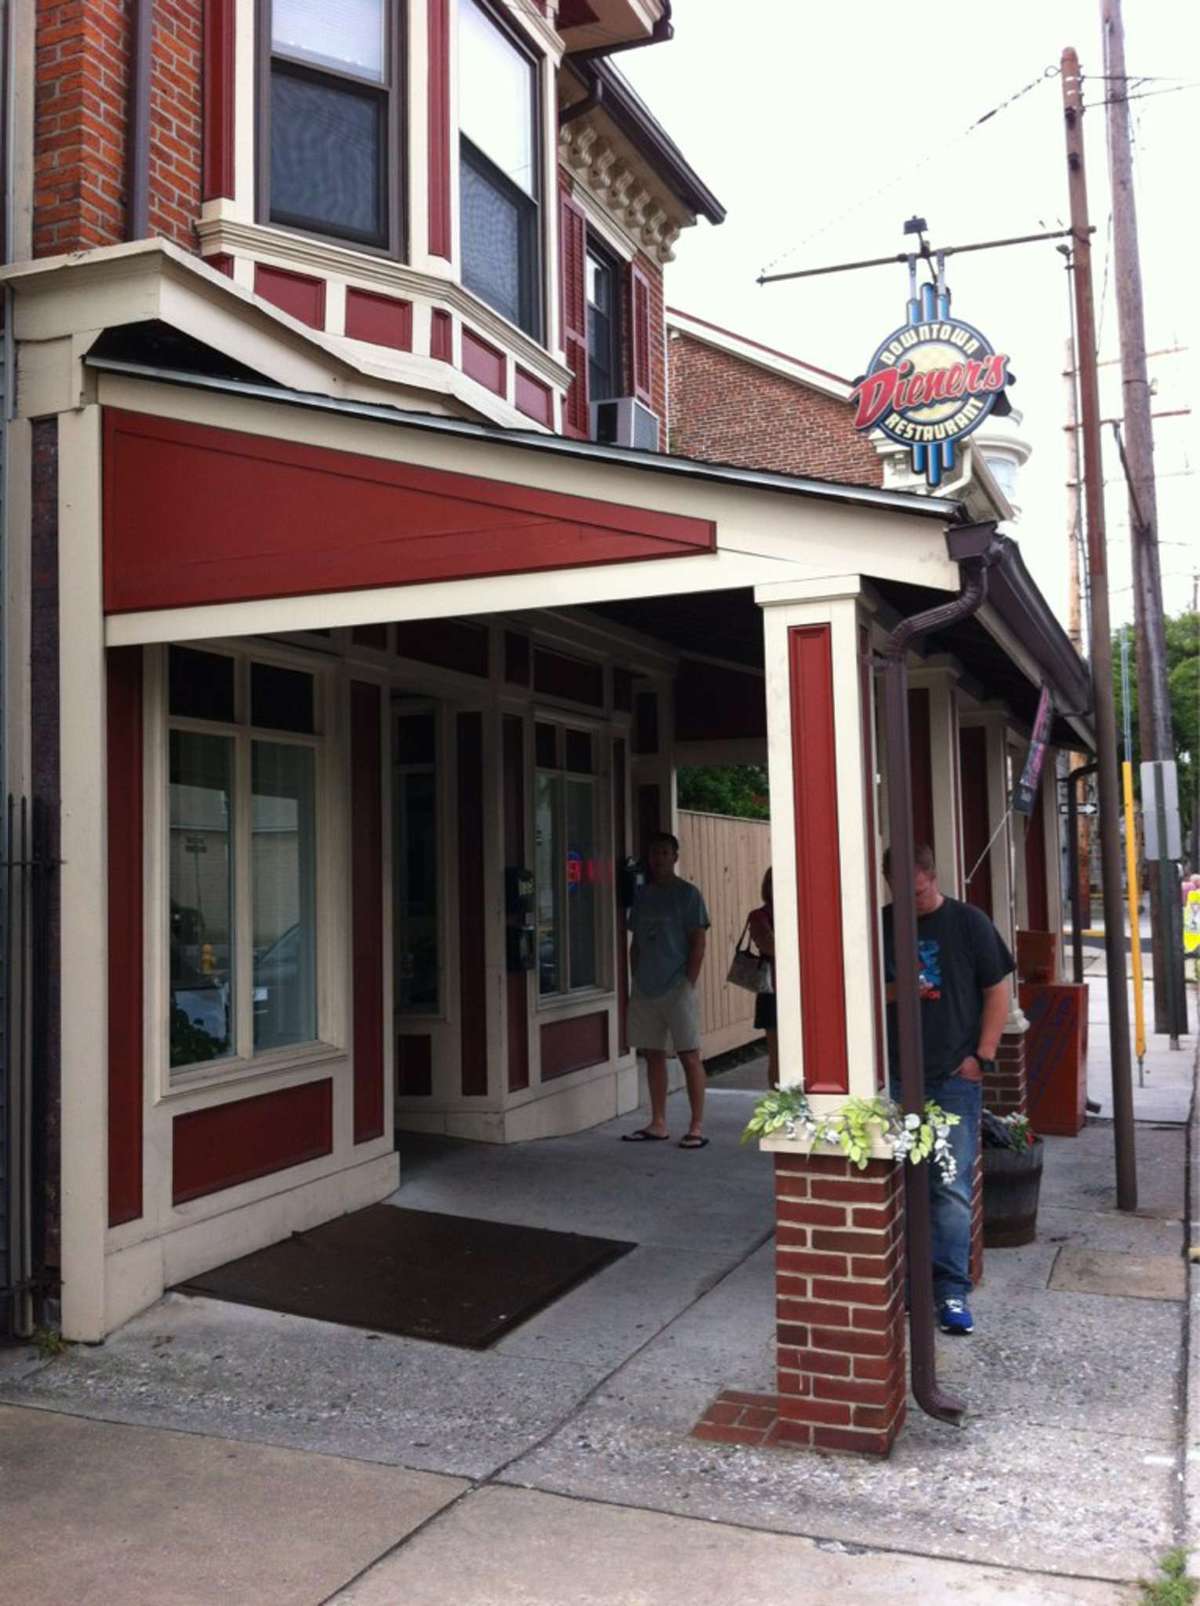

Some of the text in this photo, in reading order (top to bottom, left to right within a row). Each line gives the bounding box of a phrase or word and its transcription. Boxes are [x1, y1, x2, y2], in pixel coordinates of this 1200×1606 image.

[880, 324, 980, 365] DOWNTOWN
[849, 354, 1006, 429] Diener's
[884, 397, 983, 441] RESTAURANT
